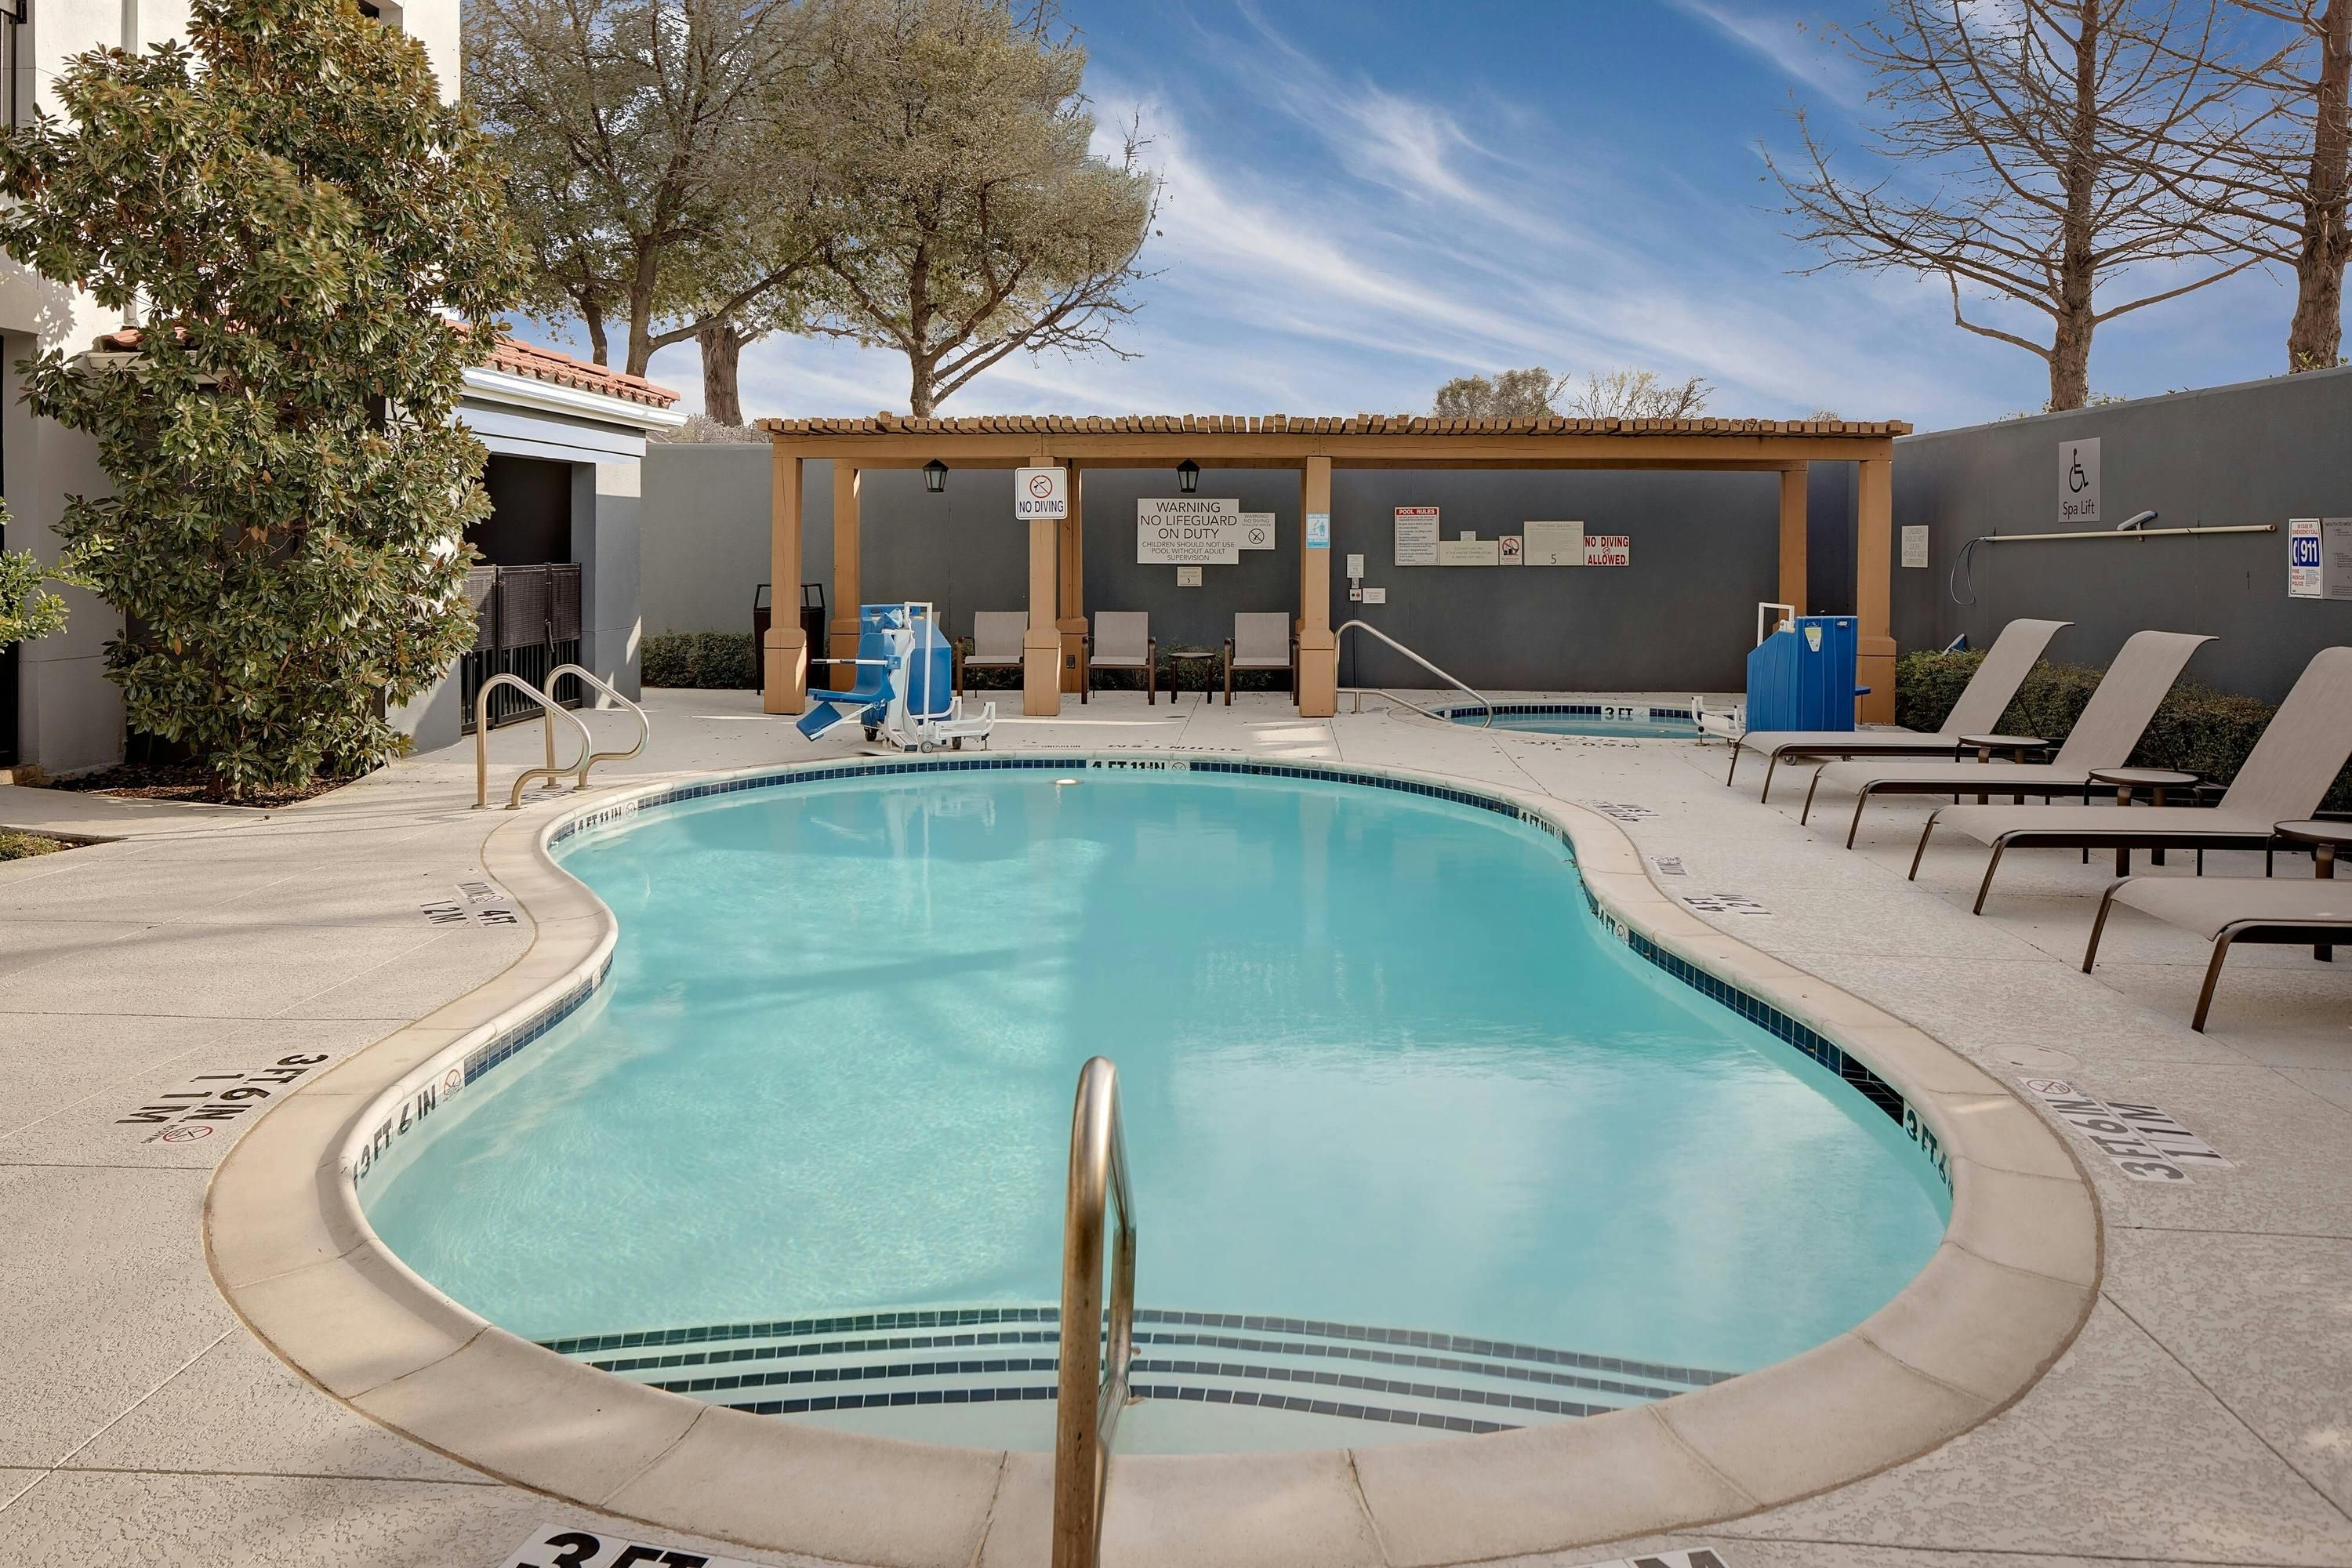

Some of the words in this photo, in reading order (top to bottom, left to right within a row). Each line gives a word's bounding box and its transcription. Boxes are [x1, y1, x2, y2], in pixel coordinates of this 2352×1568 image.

[1019, 500, 1033, 513] NO
[1035, 500, 1064, 513] DIVING
[1156, 502, 1221, 513] WARNING
[2063, 501, 2078, 520] Spa
[2081, 499, 2095, 514] Lift
[1141, 515, 1162, 526] NO
[1166, 515, 1237, 526] LIFEGUARD
[1158, 528, 1179, 539] ON
[1184, 528, 1220, 539] DUTY
[1585, 537, 1596, 547] NO
[1601, 536, 1628, 547] DIVING
[2300, 539, 2318, 563] 911
[1551, 554, 1557, 564] 5
[1605, 706, 1615, 715] 3
[1092, 760, 1102, 769] 4
[1108, 760, 1127, 769] FT
[578, 819, 583, 830] 4
[586, 814, 597, 827] FT
[1522, 812, 1526, 822] 4
[1530, 815, 1540, 828] FT
[1599, 909, 1604, 925] 4
[1606, 914, 1615, 935] FT
[276, 1054, 329, 1066] 3
[241, 1068, 310, 1084] FT.
[219, 1087, 272, 1101] 6
[178, 1104, 254, 1123] IN.
[2067, 1119, 2129, 1134] 6
[361, 1144, 370, 1179] 3
[397, 1102, 412, 1136] 6
[1906, 1109, 1918, 1142] 3
[1938, 1152, 1947, 1184] 6
[2120, 1161, 2185, 1180] 3
